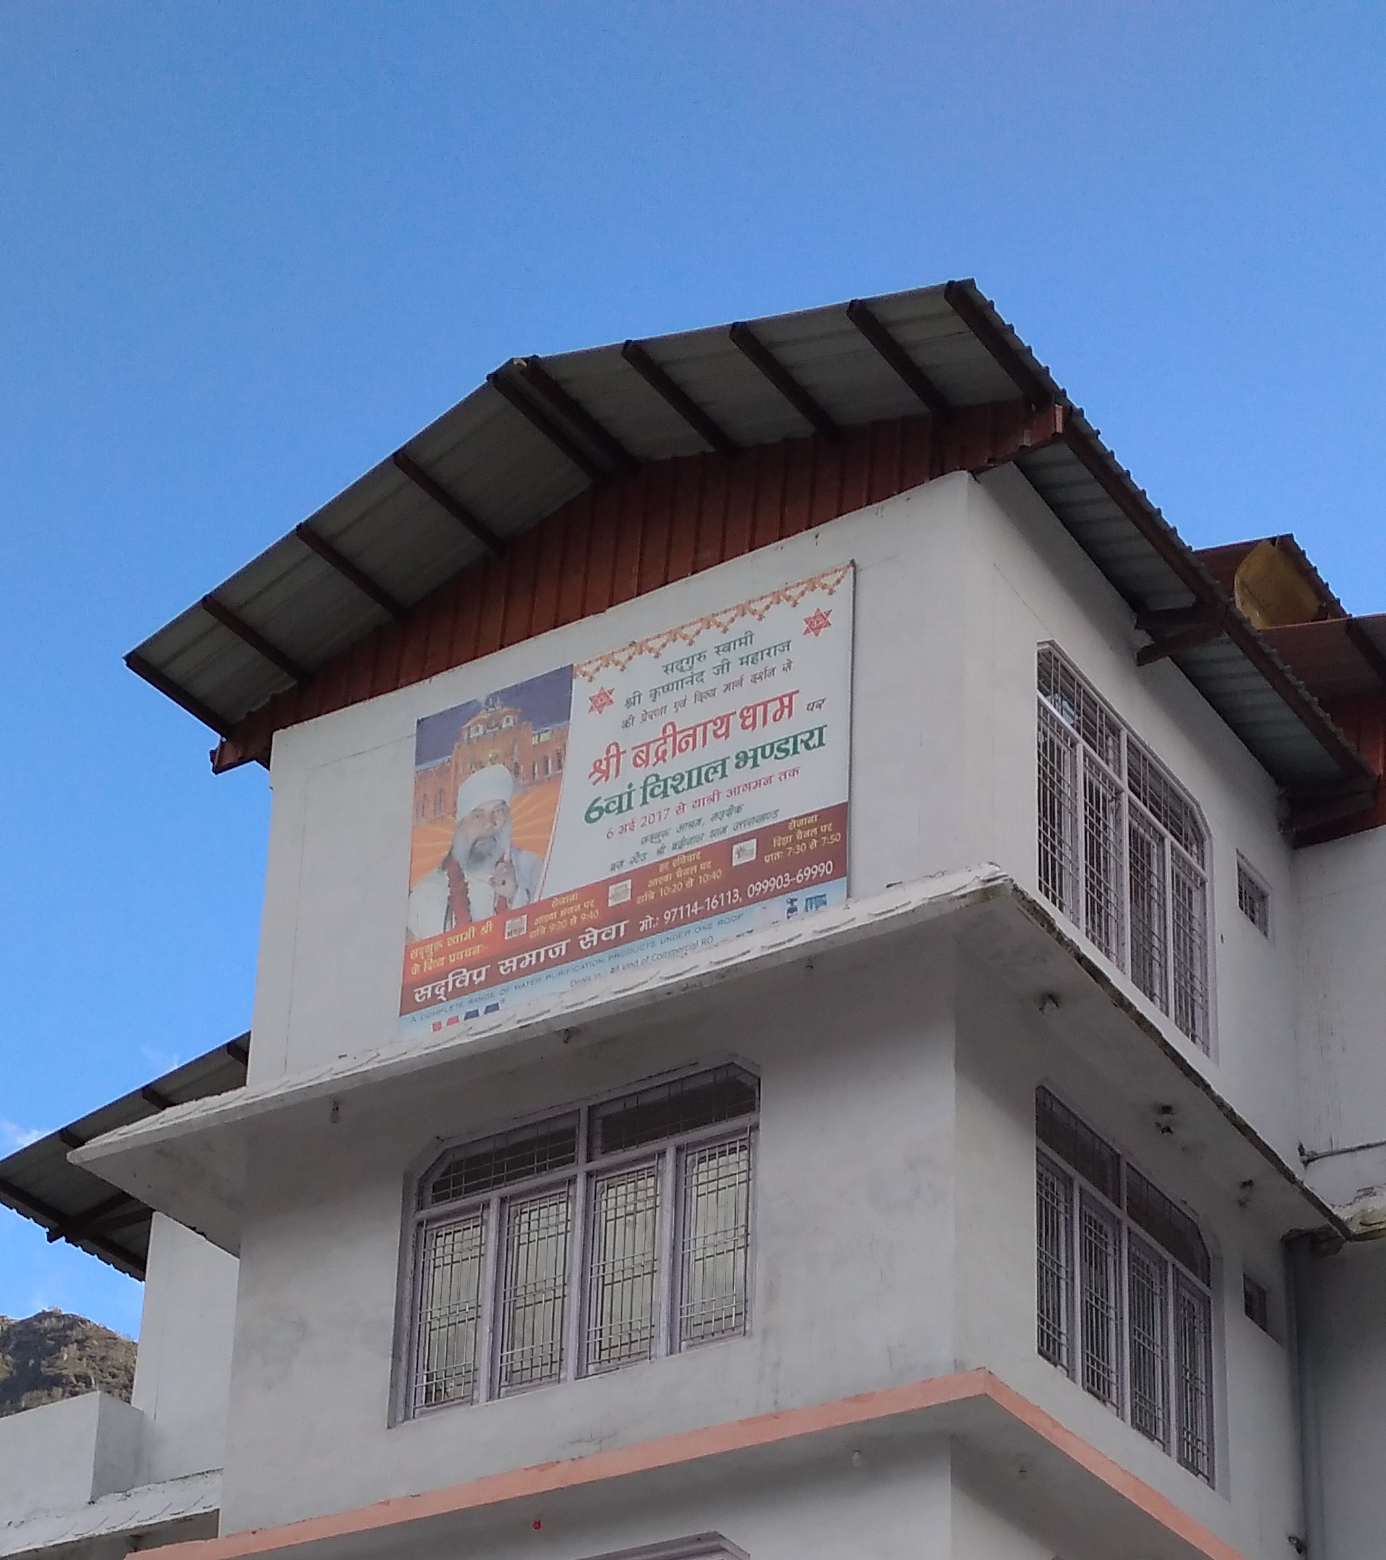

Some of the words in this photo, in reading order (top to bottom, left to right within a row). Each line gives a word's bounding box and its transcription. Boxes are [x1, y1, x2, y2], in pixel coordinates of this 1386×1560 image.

[624, 692, 643, 709] श्री
[649, 670, 706, 703] कृष्णानंद
[712, 658, 732, 676] जी
[739, 640, 792, 667] महाराज
[662, 650, 708, 676] सद्गुरु
[714, 630, 755, 657] स्वामी
[588, 741, 627, 786] श्री
[631, 710, 737, 769] बद्रीनाथ
[739, 689, 800, 732] धाम
[806, 697, 827, 712] पर
[583, 782, 637, 824] 6वां
[639, 756, 730, 807] विशाल
[734, 725, 828, 770] भण्डारा
[606, 828, 614, 840] 6
[618, 817, 636, 836] मई
[641, 808, 670, 828] 2017
[675, 802, 687, 816] से
[692, 788, 722, 809] यात्री
[727, 775, 775, 799] आगमन
[778, 766, 800, 783] तक
[787, 843, 807, 858] 7:30
[809, 837, 820, 851] से
[821, 833, 842, 848] 7:50
[820, 822, 833, 834] पर
[659, 883, 683, 898] 10:20
[699, 869, 723, 885] 10:40
[413, 968, 491, 1003] सद्विप्र
[498, 939, 571, 976] समाज
[577, 920, 629, 951] सेवा
[663, 888, 742, 925] 97114-16113,
[747, 861, 834, 899] 099903-69990
[480, 920, 494, 936] श्री
[514, 978, 543, 992] WATER
[545, 954, 606, 982] PURIFICATION
[608, 941, 656, 961] PRODUCTS
[659, 929, 692, 944] UNDER
[695, 922, 713, 934] ONE
[717, 912, 745, 926] ROOF
